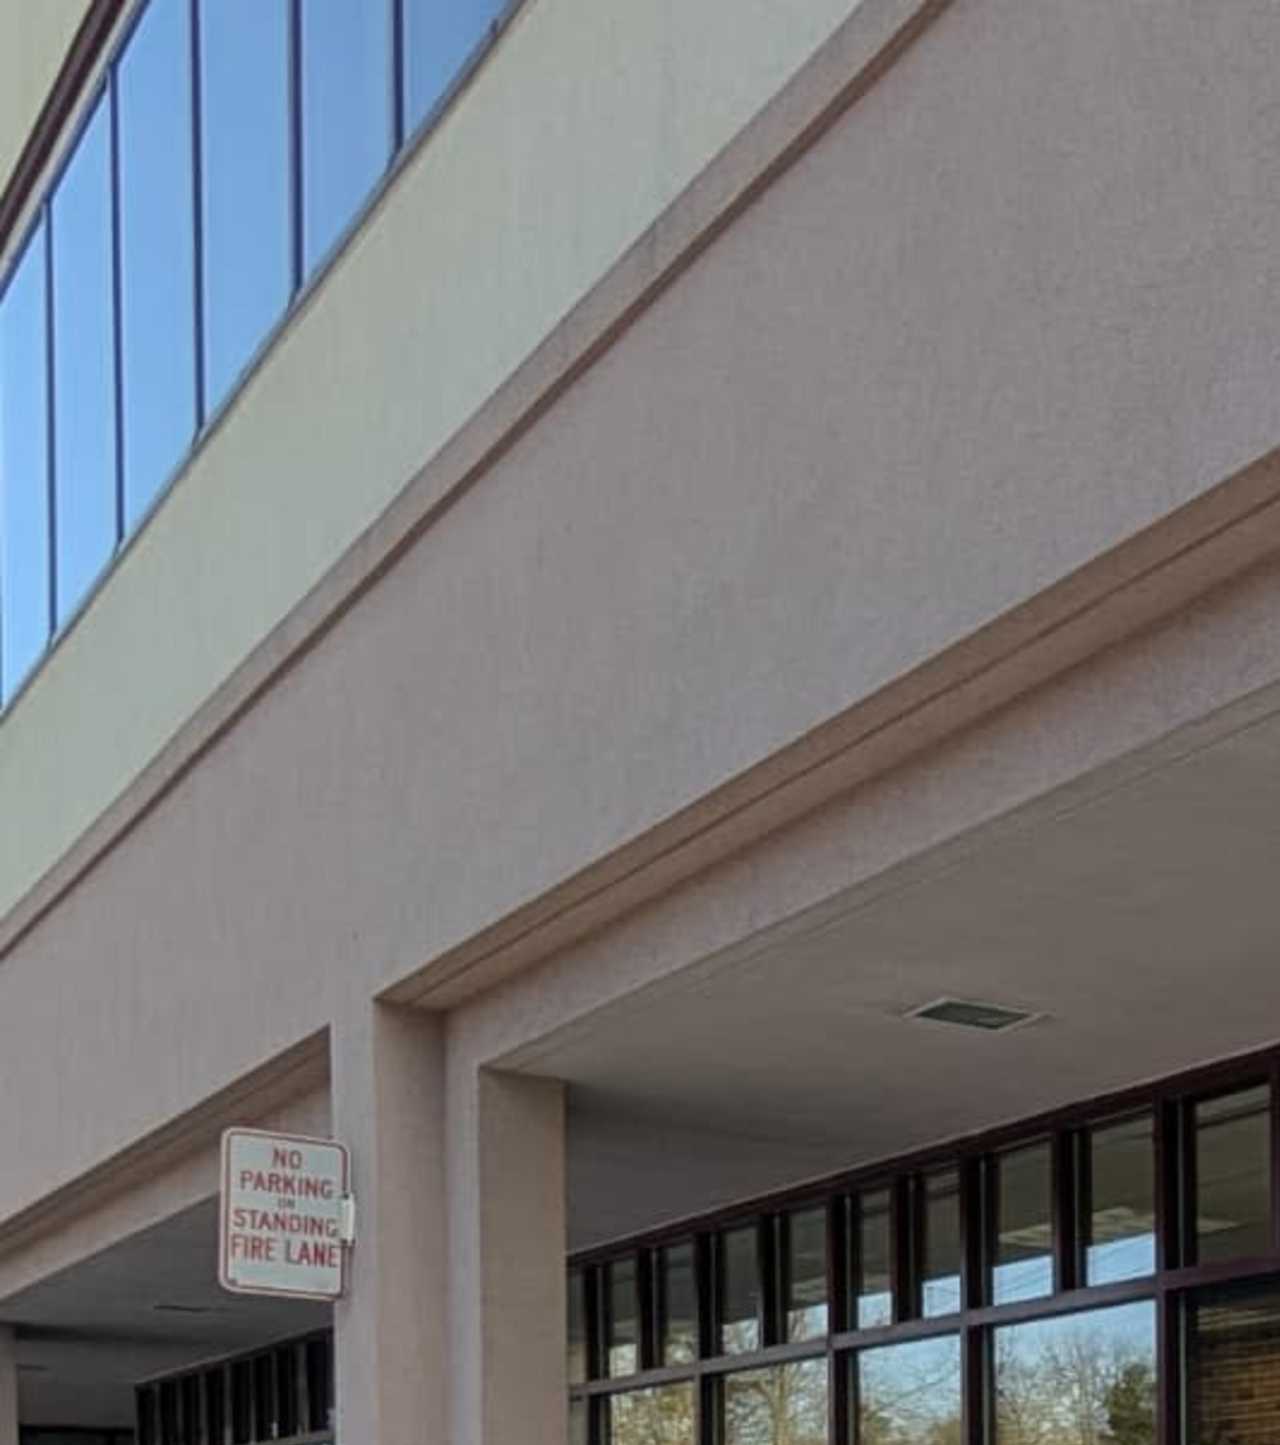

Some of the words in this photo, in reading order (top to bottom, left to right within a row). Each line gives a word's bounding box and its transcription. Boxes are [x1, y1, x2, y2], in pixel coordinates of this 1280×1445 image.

[273, 1148, 302, 1169] NO
[240, 1171, 333, 1199] PARKING
[233, 1209, 339, 1237] STANDING
[230, 1234, 276, 1261] FIRE
[285, 1240, 339, 1267] LANE
